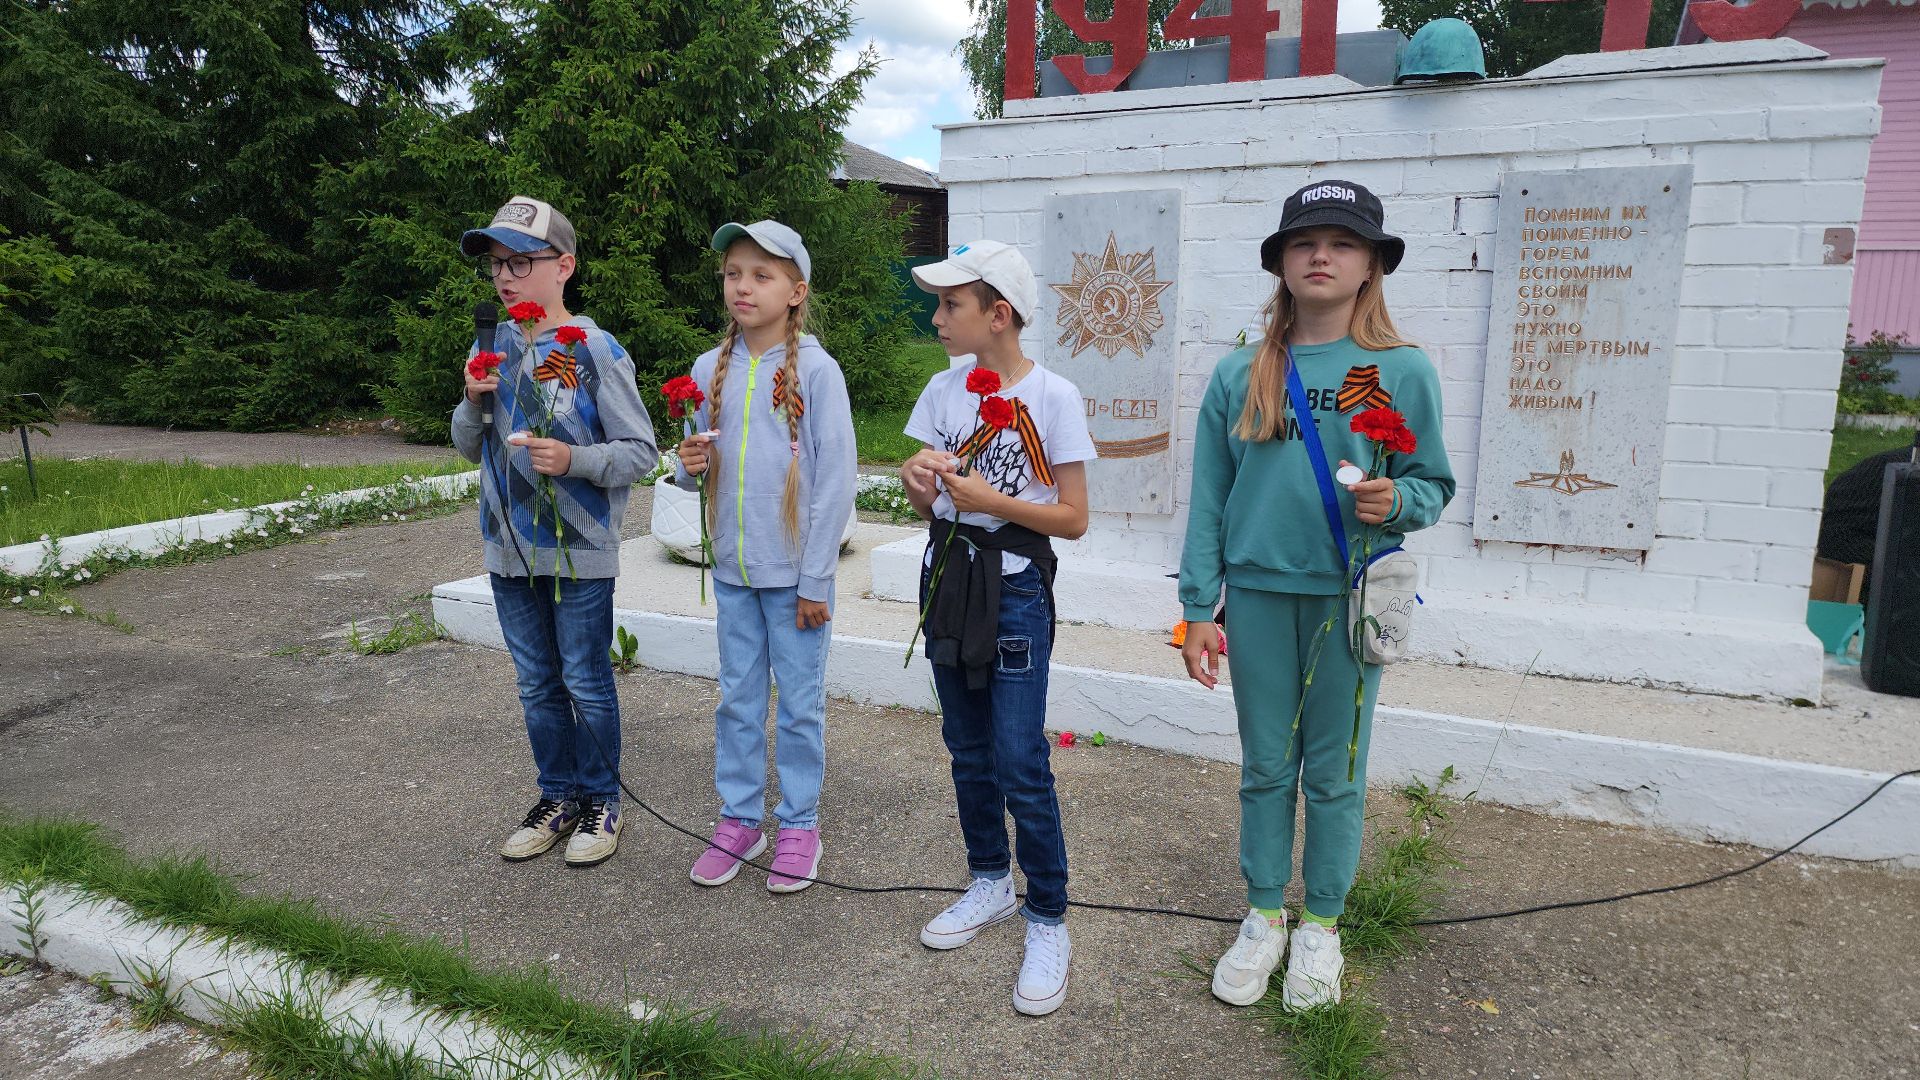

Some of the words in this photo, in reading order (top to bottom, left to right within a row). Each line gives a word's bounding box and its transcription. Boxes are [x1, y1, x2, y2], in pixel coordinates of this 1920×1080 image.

[1301, 185, 1356, 205] RUSSIA
[1524, 206, 1611, 224] ПОМНИМ
[1621, 205, 1648, 221] ИХ
[1521, 225, 1632, 243] ПОИМЕННО
[1520, 246, 1590, 262] ГОРЕМ
[1519, 264, 1633, 281] ВСПОМНИМ
[1518, 283, 1588, 300] СВОИМ
[1516, 301, 1556, 318] ЭТО
[1514, 322, 1582, 337] НУЖНО
[1512, 340, 1537, 354] НЕ
[1511, 356, 1551, 373] ЭТО
[1509, 377, 1562, 391] НАДО
